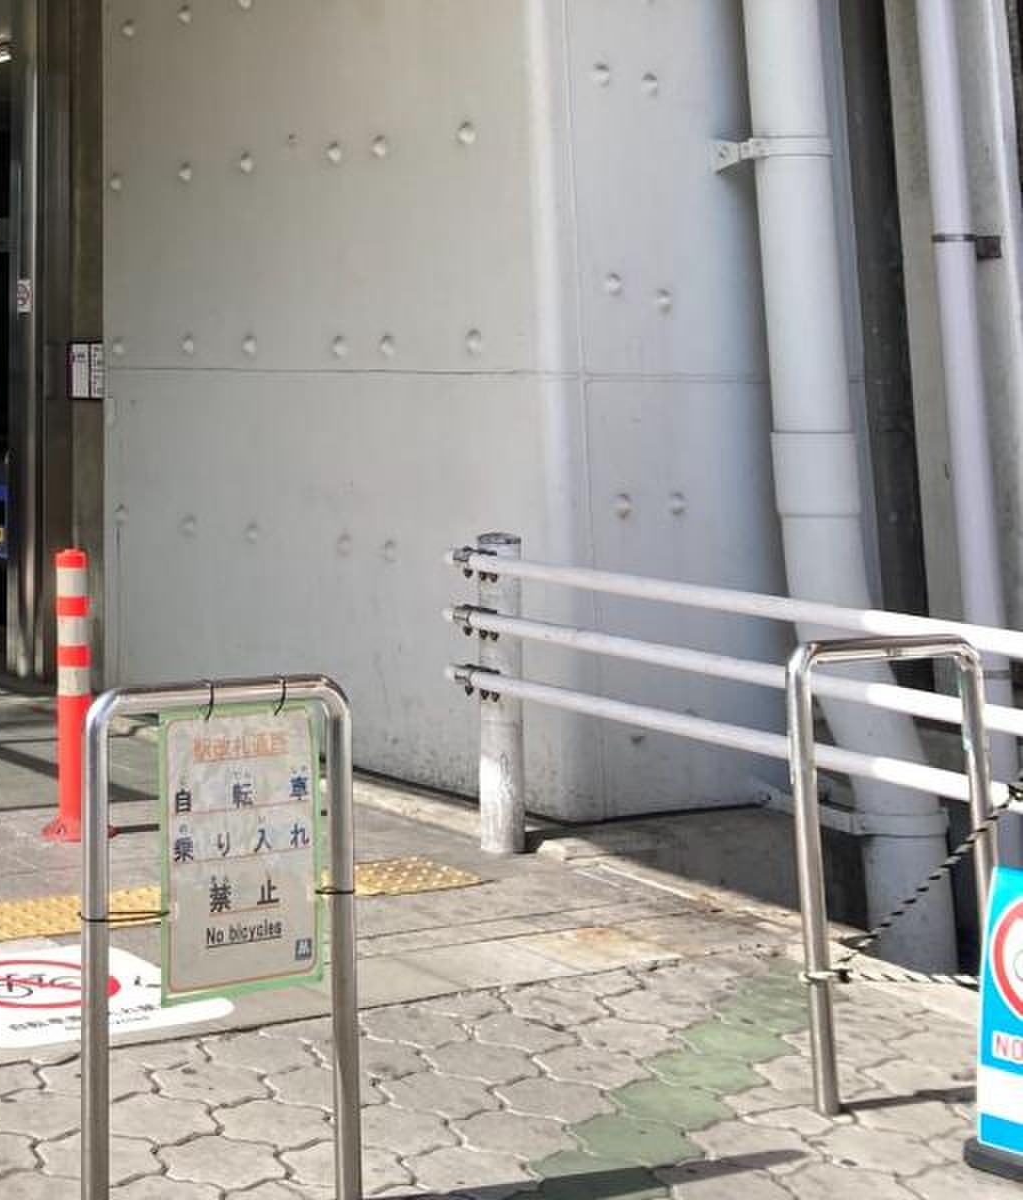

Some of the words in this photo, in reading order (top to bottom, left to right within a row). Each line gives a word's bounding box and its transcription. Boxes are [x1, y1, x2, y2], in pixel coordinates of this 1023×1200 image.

[173, 823, 311, 862] 乗り入れ
[209, 879, 280, 913] 禁止
[206, 926, 226, 945] No
[228, 919, 283, 944] bicycles
